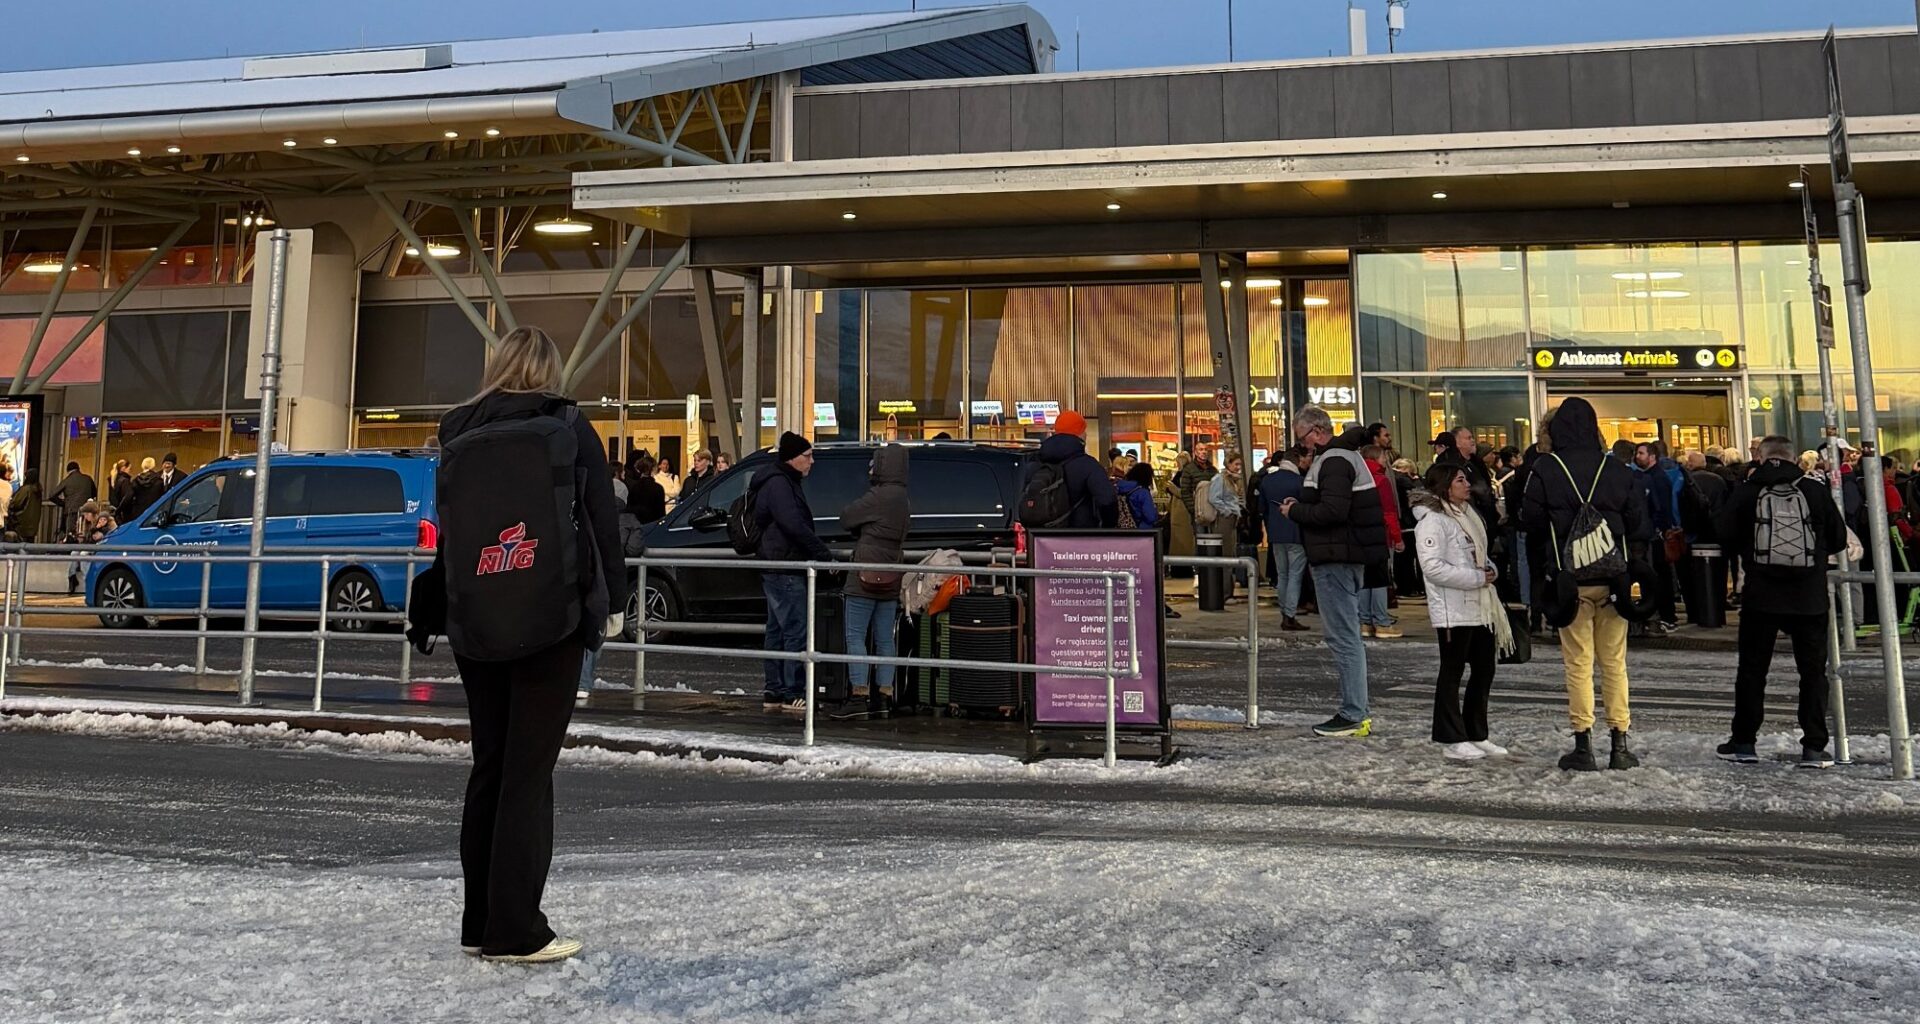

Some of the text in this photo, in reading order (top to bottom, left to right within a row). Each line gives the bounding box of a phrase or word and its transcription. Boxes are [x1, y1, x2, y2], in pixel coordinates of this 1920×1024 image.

[1559, 351, 1679, 366] Ankomst Arrivals
[1090, 553, 1101, 562] og
[1063, 613, 1080, 623] Taxi
[1081, 615, 1106, 623] owner
[1080, 624, 1106, 634] driver
[1055, 637, 1067, 646] For
[1050, 649, 1085, 658] questions
